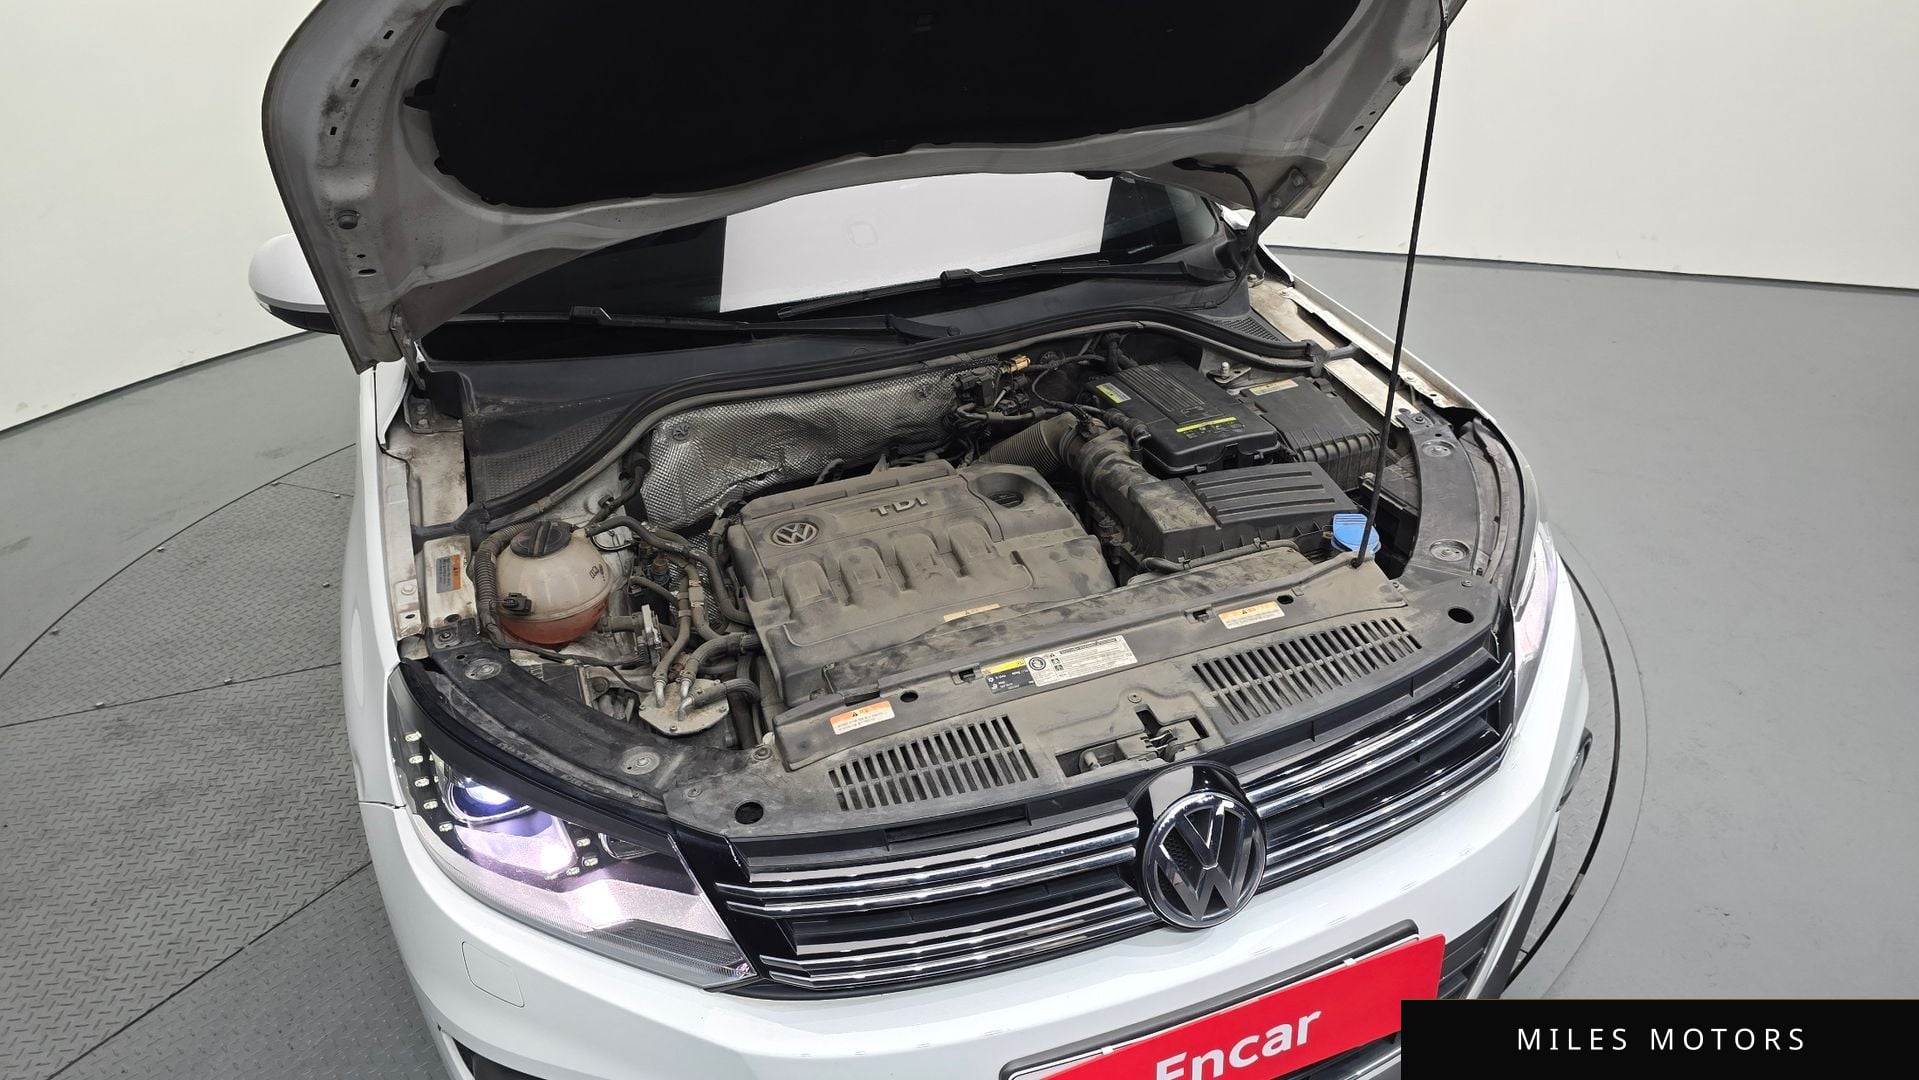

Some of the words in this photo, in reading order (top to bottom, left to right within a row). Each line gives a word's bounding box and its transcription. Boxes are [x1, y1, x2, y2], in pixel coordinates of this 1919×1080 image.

[870, 496, 928, 517] TDI
[772, 521, 818, 546] VW
[1146, 793, 1264, 926] VW
[1156, 1010, 1322, 1080] Encar
